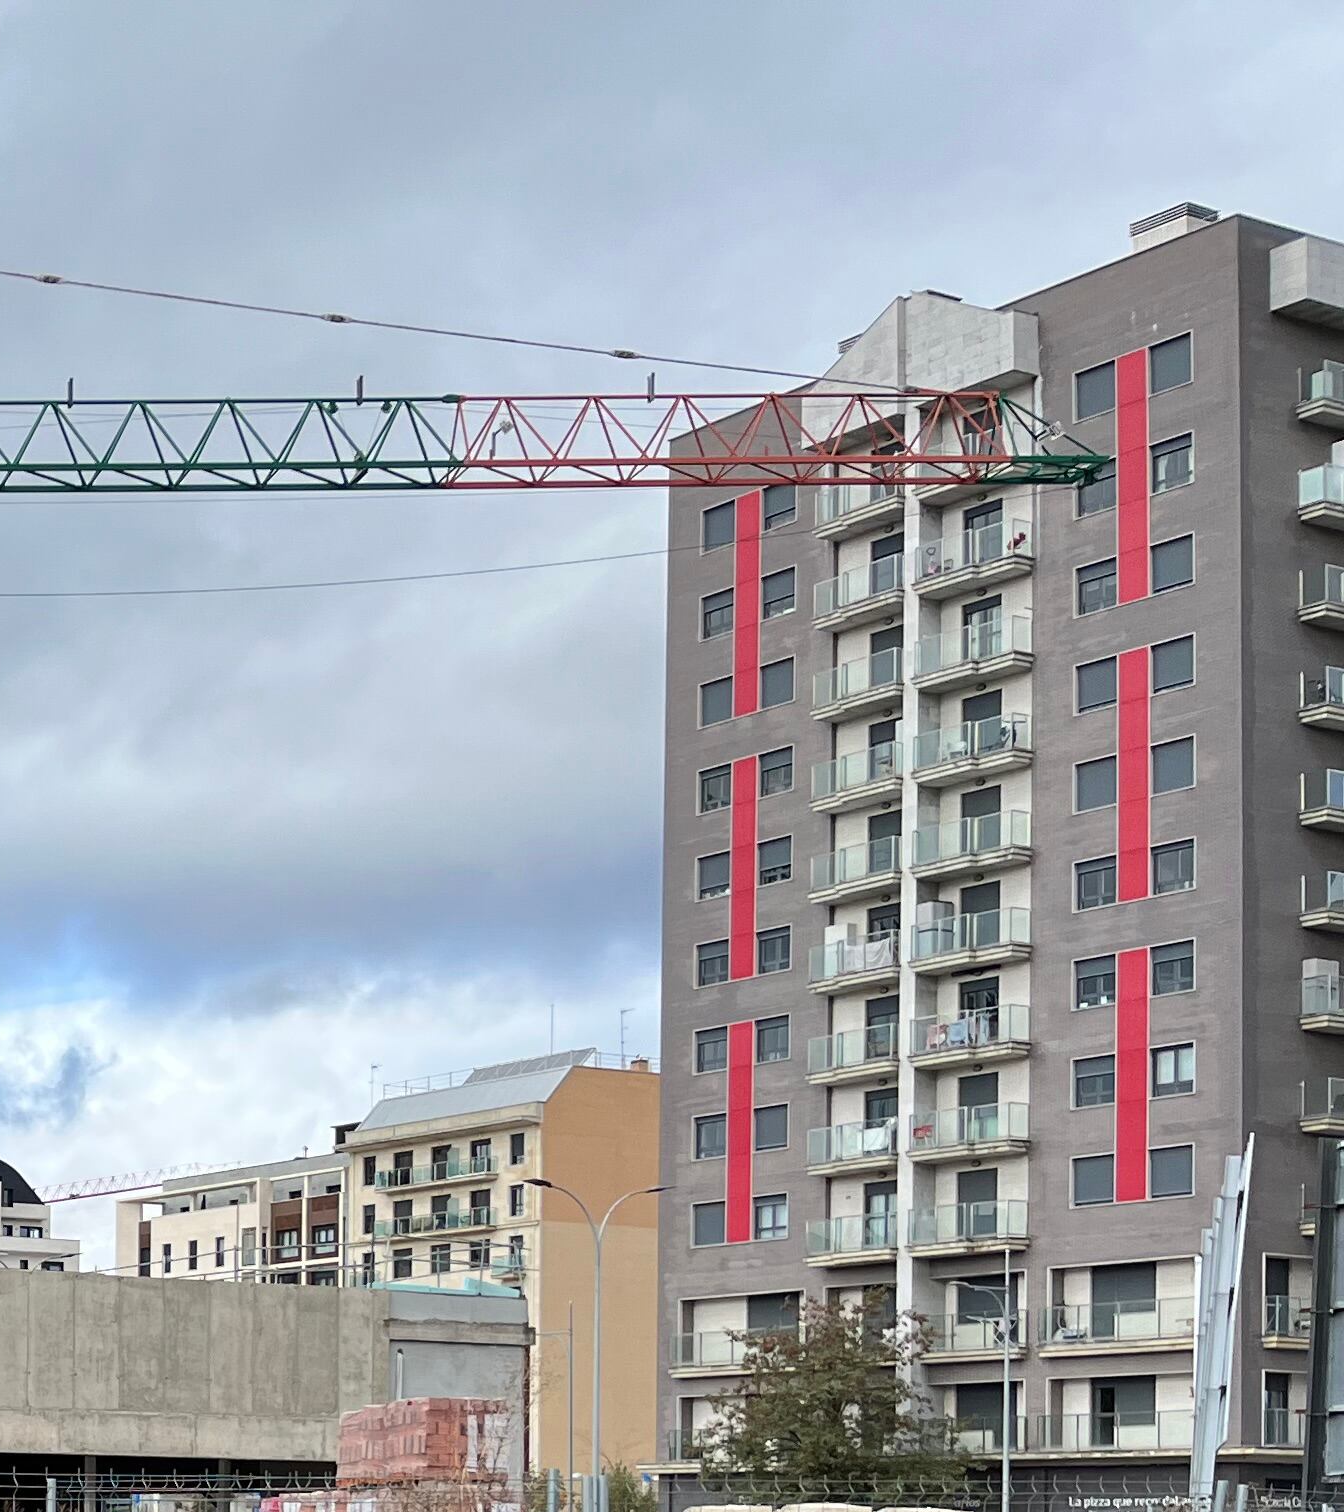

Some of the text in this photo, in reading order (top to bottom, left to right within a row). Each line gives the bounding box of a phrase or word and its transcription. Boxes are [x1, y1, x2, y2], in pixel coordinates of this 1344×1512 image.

[1069, 1495, 1082, 1507] La
[1083, 1496, 1111, 1510] pizza
[1112, 1496, 1133, 1510] que
